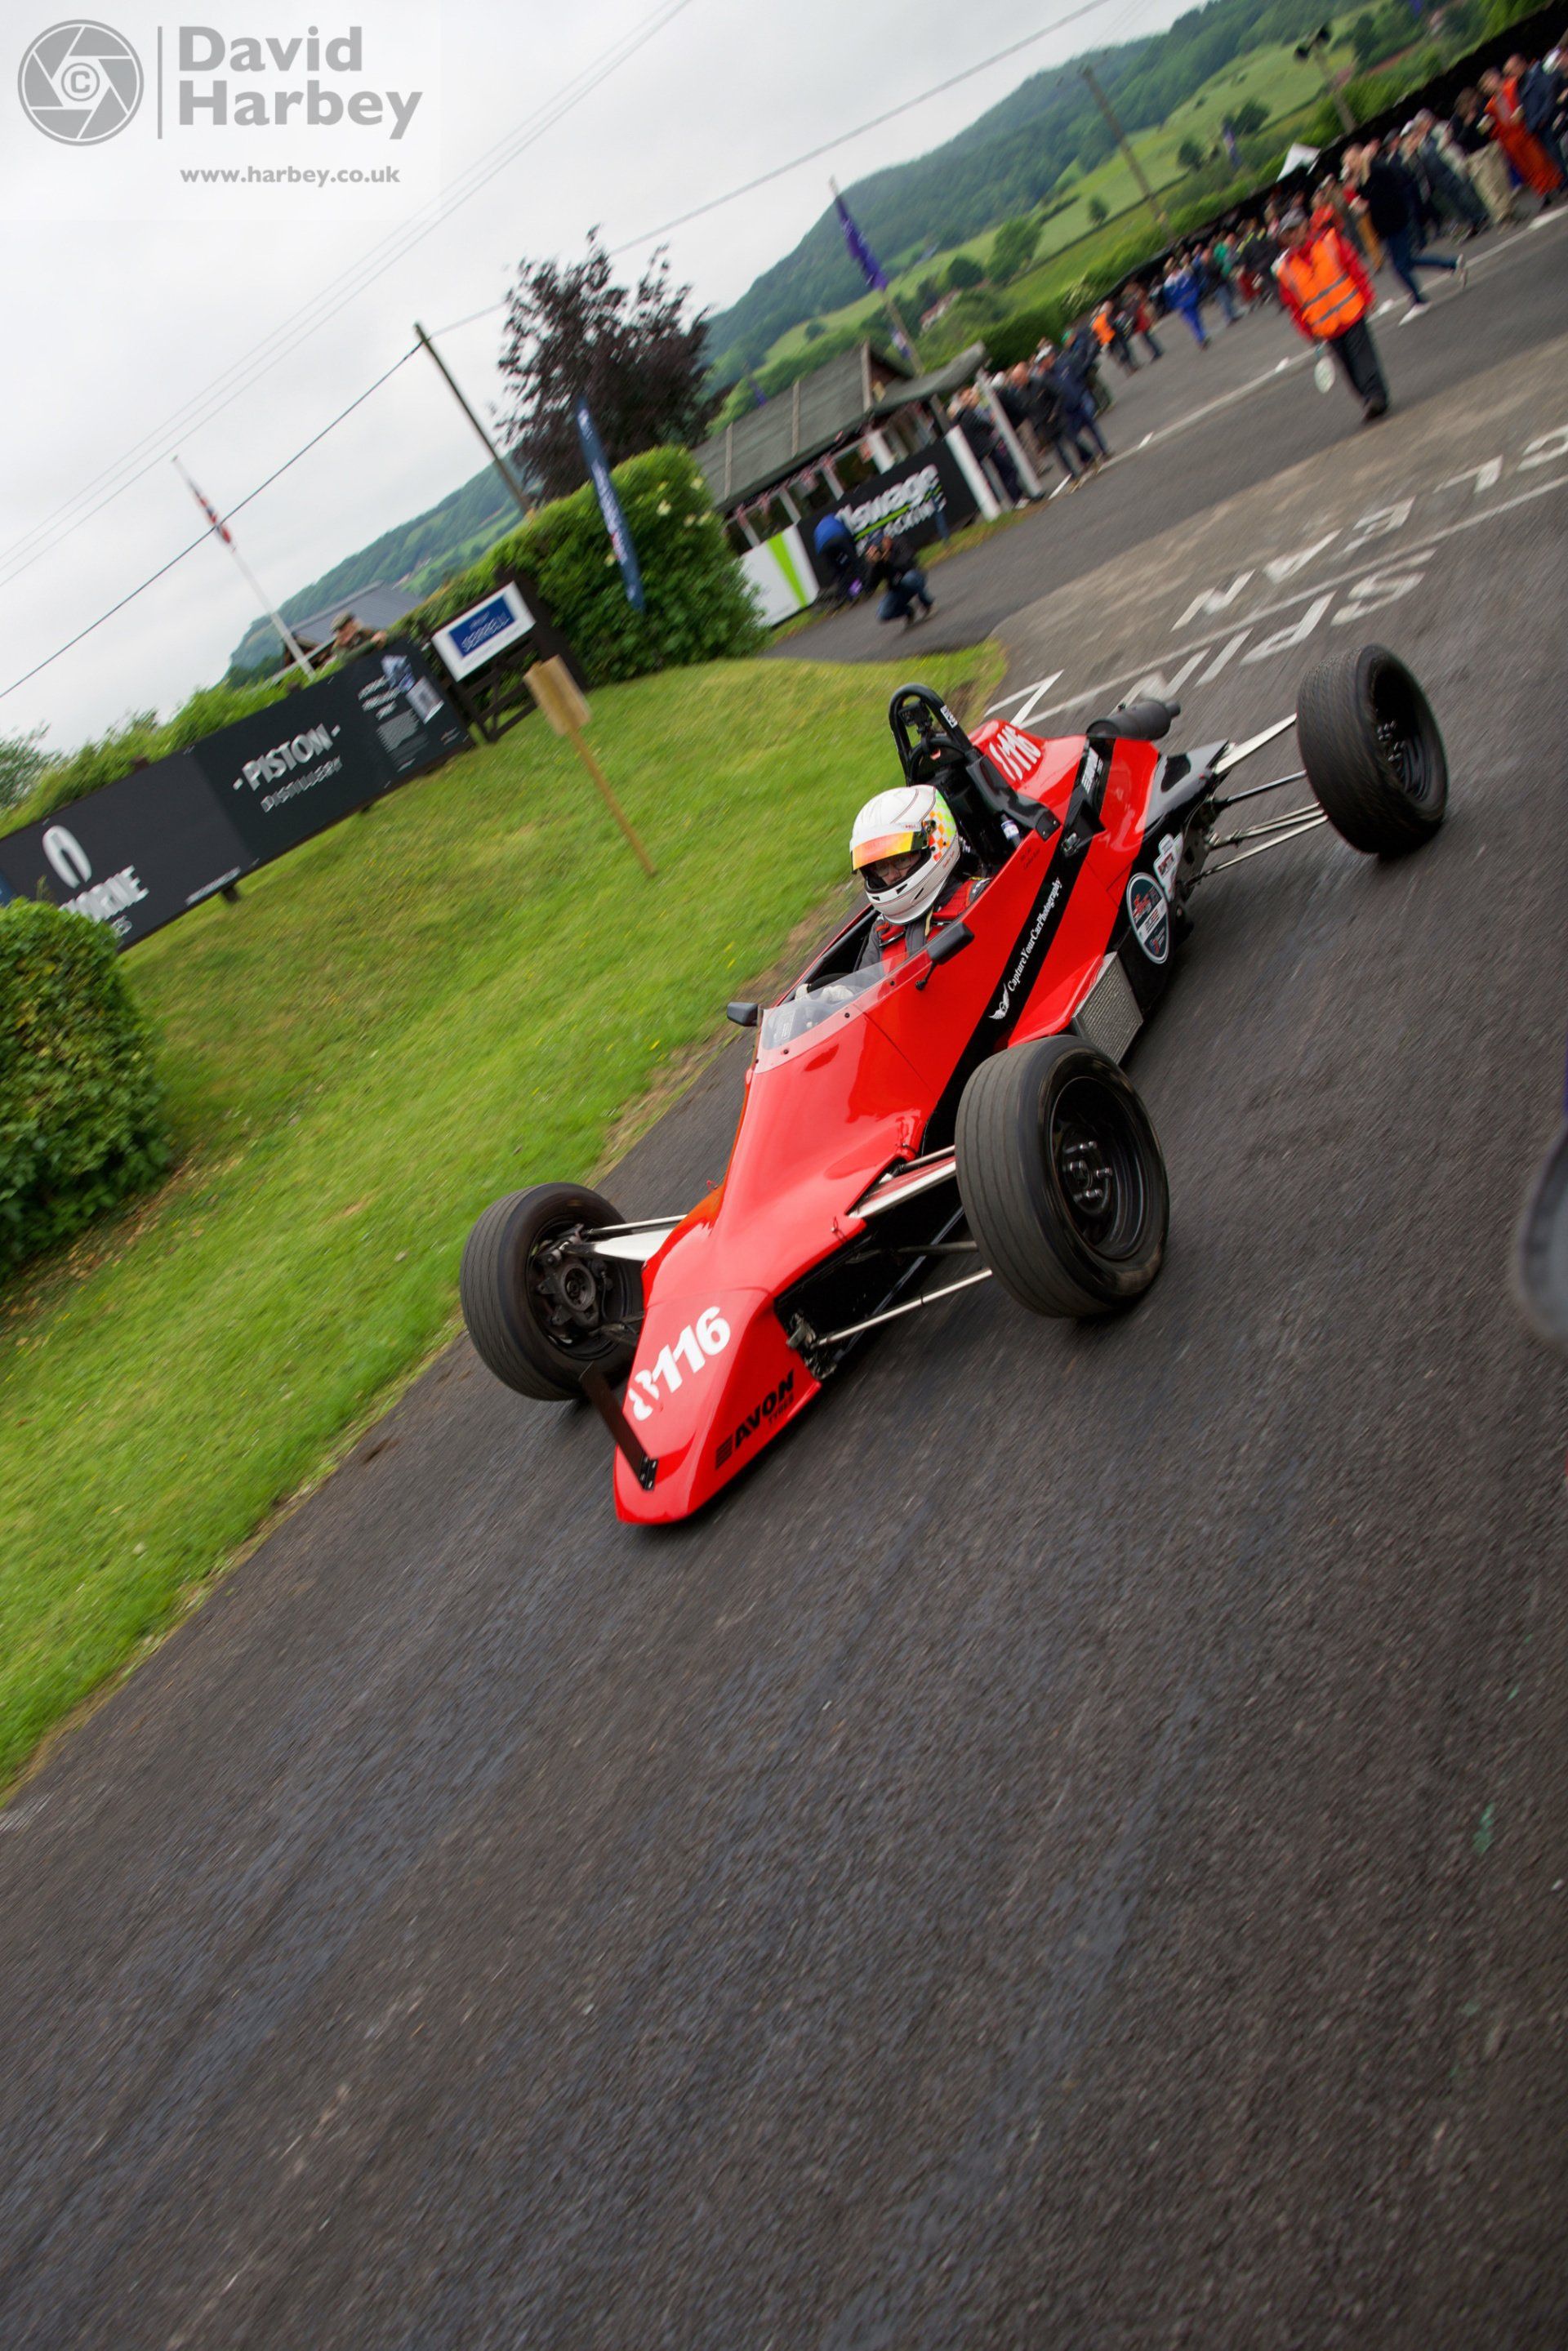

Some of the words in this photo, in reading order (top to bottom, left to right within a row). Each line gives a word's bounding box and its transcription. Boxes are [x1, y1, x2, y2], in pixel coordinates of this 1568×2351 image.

[243, 723, 334, 790] PISTON
[1008, 878, 1062, 992] CaptureYourCarPhotography
[734, 1369, 795, 1449] AVON
